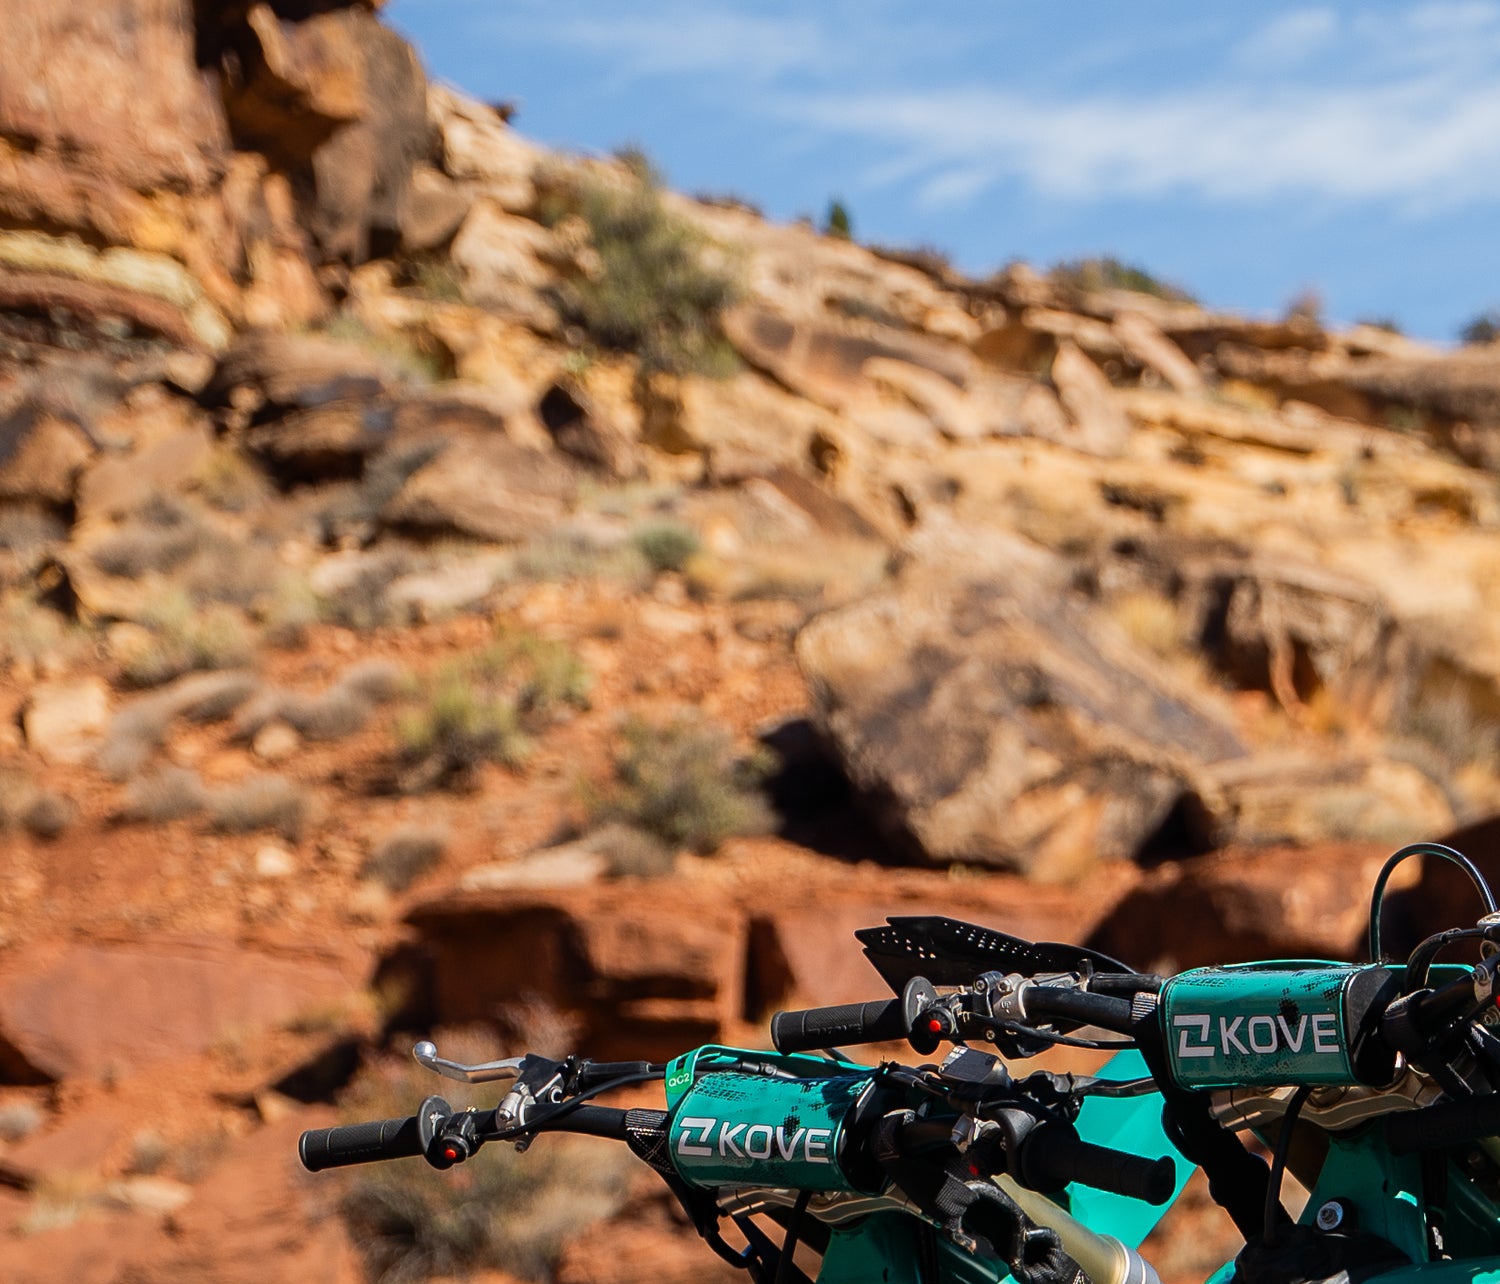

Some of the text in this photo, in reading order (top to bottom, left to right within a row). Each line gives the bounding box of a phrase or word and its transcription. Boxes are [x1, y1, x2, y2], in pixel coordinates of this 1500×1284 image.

[1219, 1013, 1340, 1055] KOVE
[668, 1073, 691, 1088] QC2
[718, 1121, 832, 1164] KOVE
